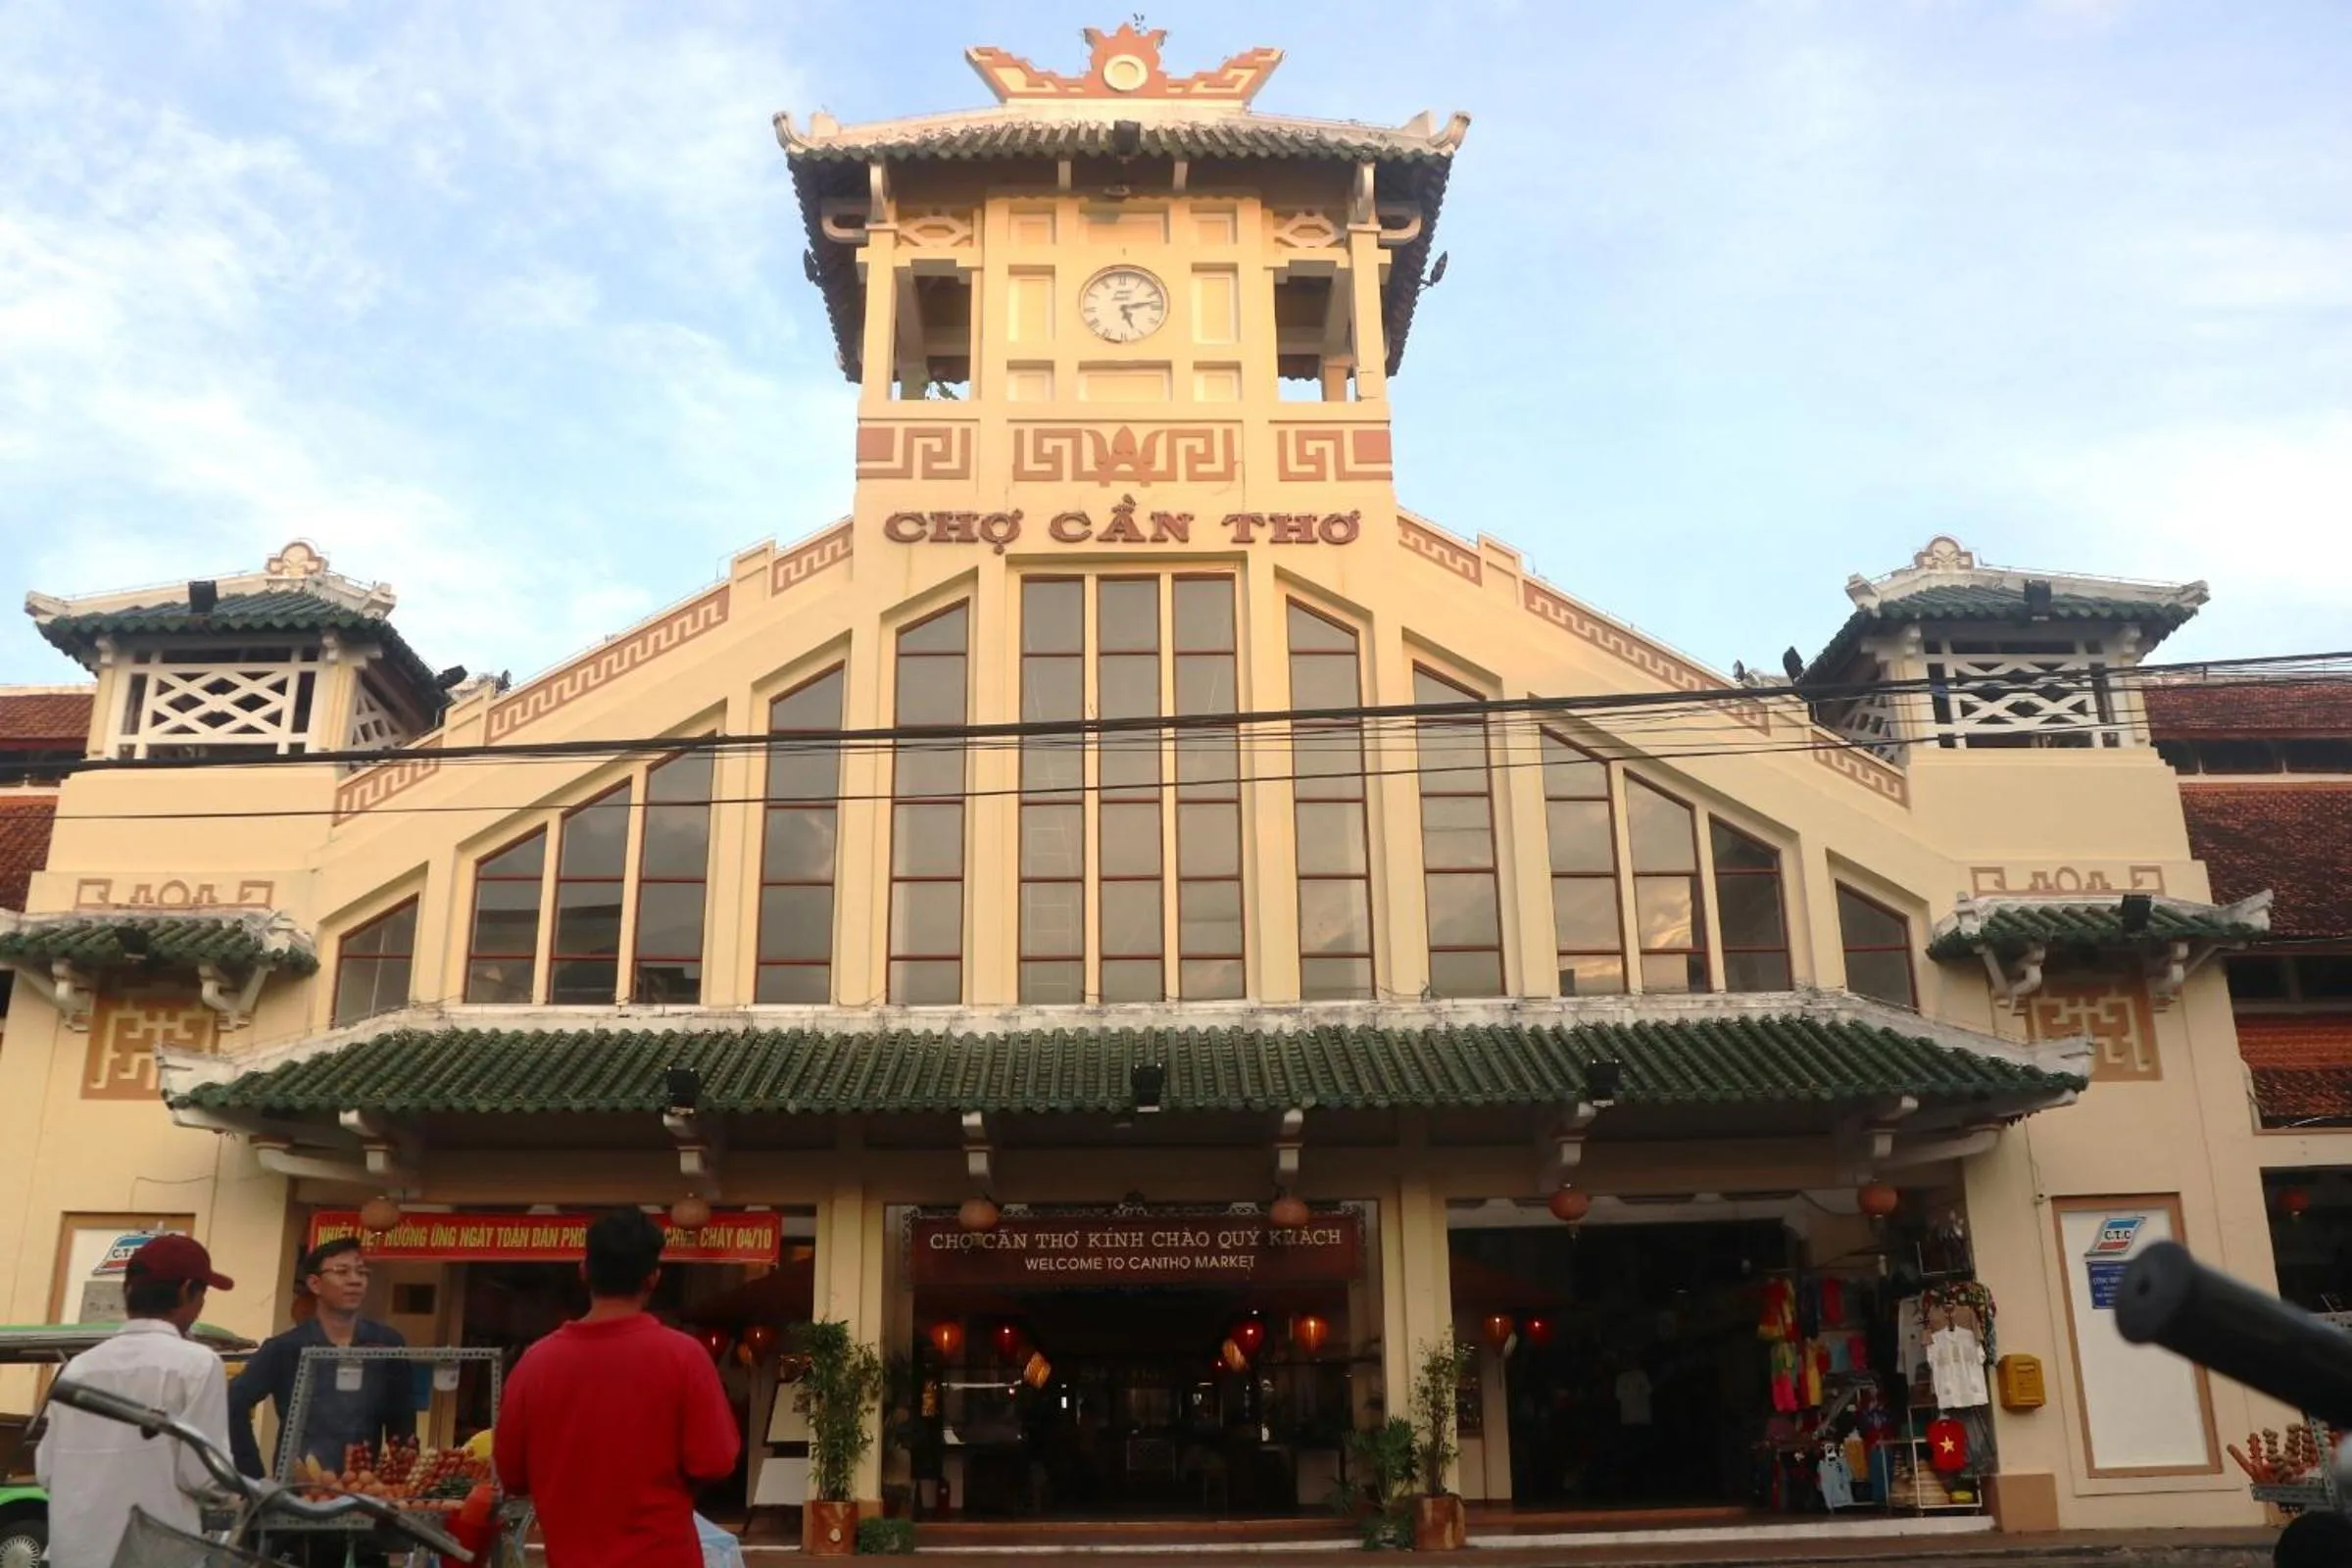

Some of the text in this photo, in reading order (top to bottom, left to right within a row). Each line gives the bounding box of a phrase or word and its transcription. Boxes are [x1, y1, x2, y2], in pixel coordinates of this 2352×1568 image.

[883, 494, 1362, 554] CHỢ CẦN THƠ
[1036, 1230, 1079, 1249] THƠ
[1088, 1227, 1145, 1249] KÍNH
[1152, 1227, 1210, 1248] CHÀO
[1217, 1226, 1260, 1249] QUÝ
[2104, 1230, 2132, 1240] C.T.C
[1025, 1254, 1255, 1271] WELCOME TO CANTHO MARKET
